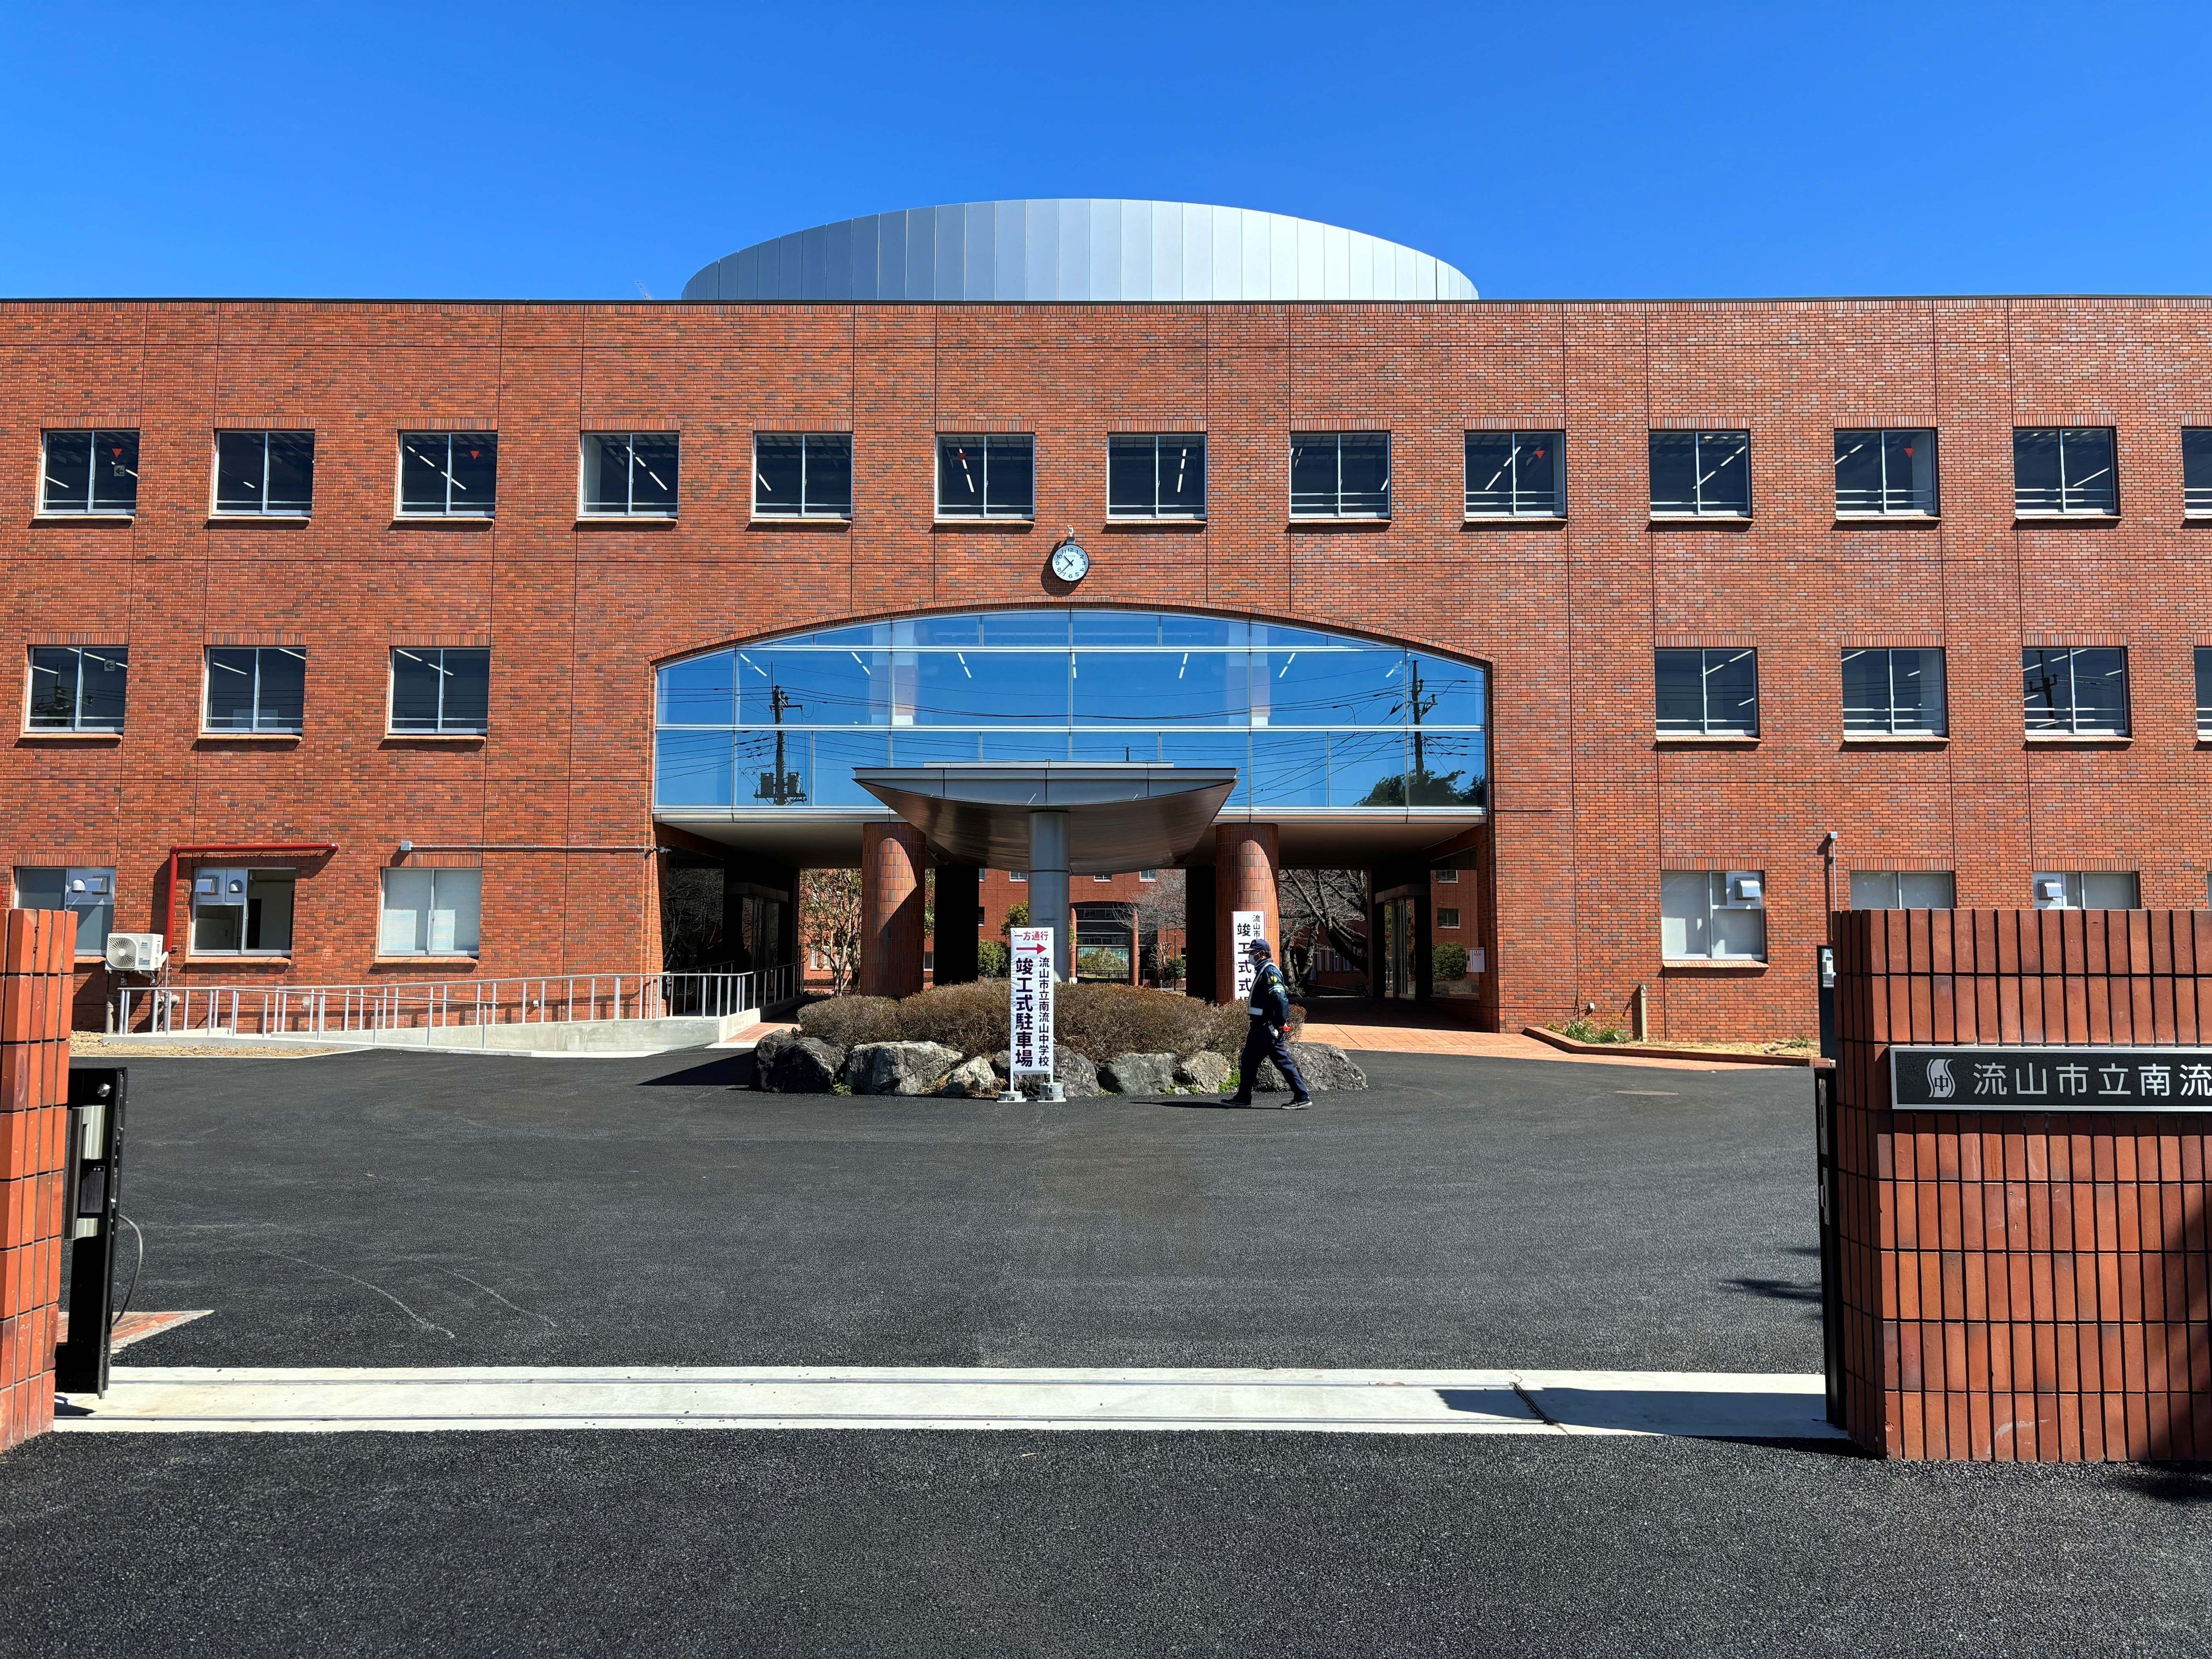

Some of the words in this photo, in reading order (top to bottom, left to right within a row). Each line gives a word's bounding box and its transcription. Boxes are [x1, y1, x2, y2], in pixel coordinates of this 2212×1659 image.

[1014, 931, 1049, 941] 一方通行
[1015, 957, 1033, 1067] 竣工式駐車場
[1039, 957, 1050, 1067] 流山市立南流山中学校
[1973, 1062, 2212, 1096] 流山市立南流
